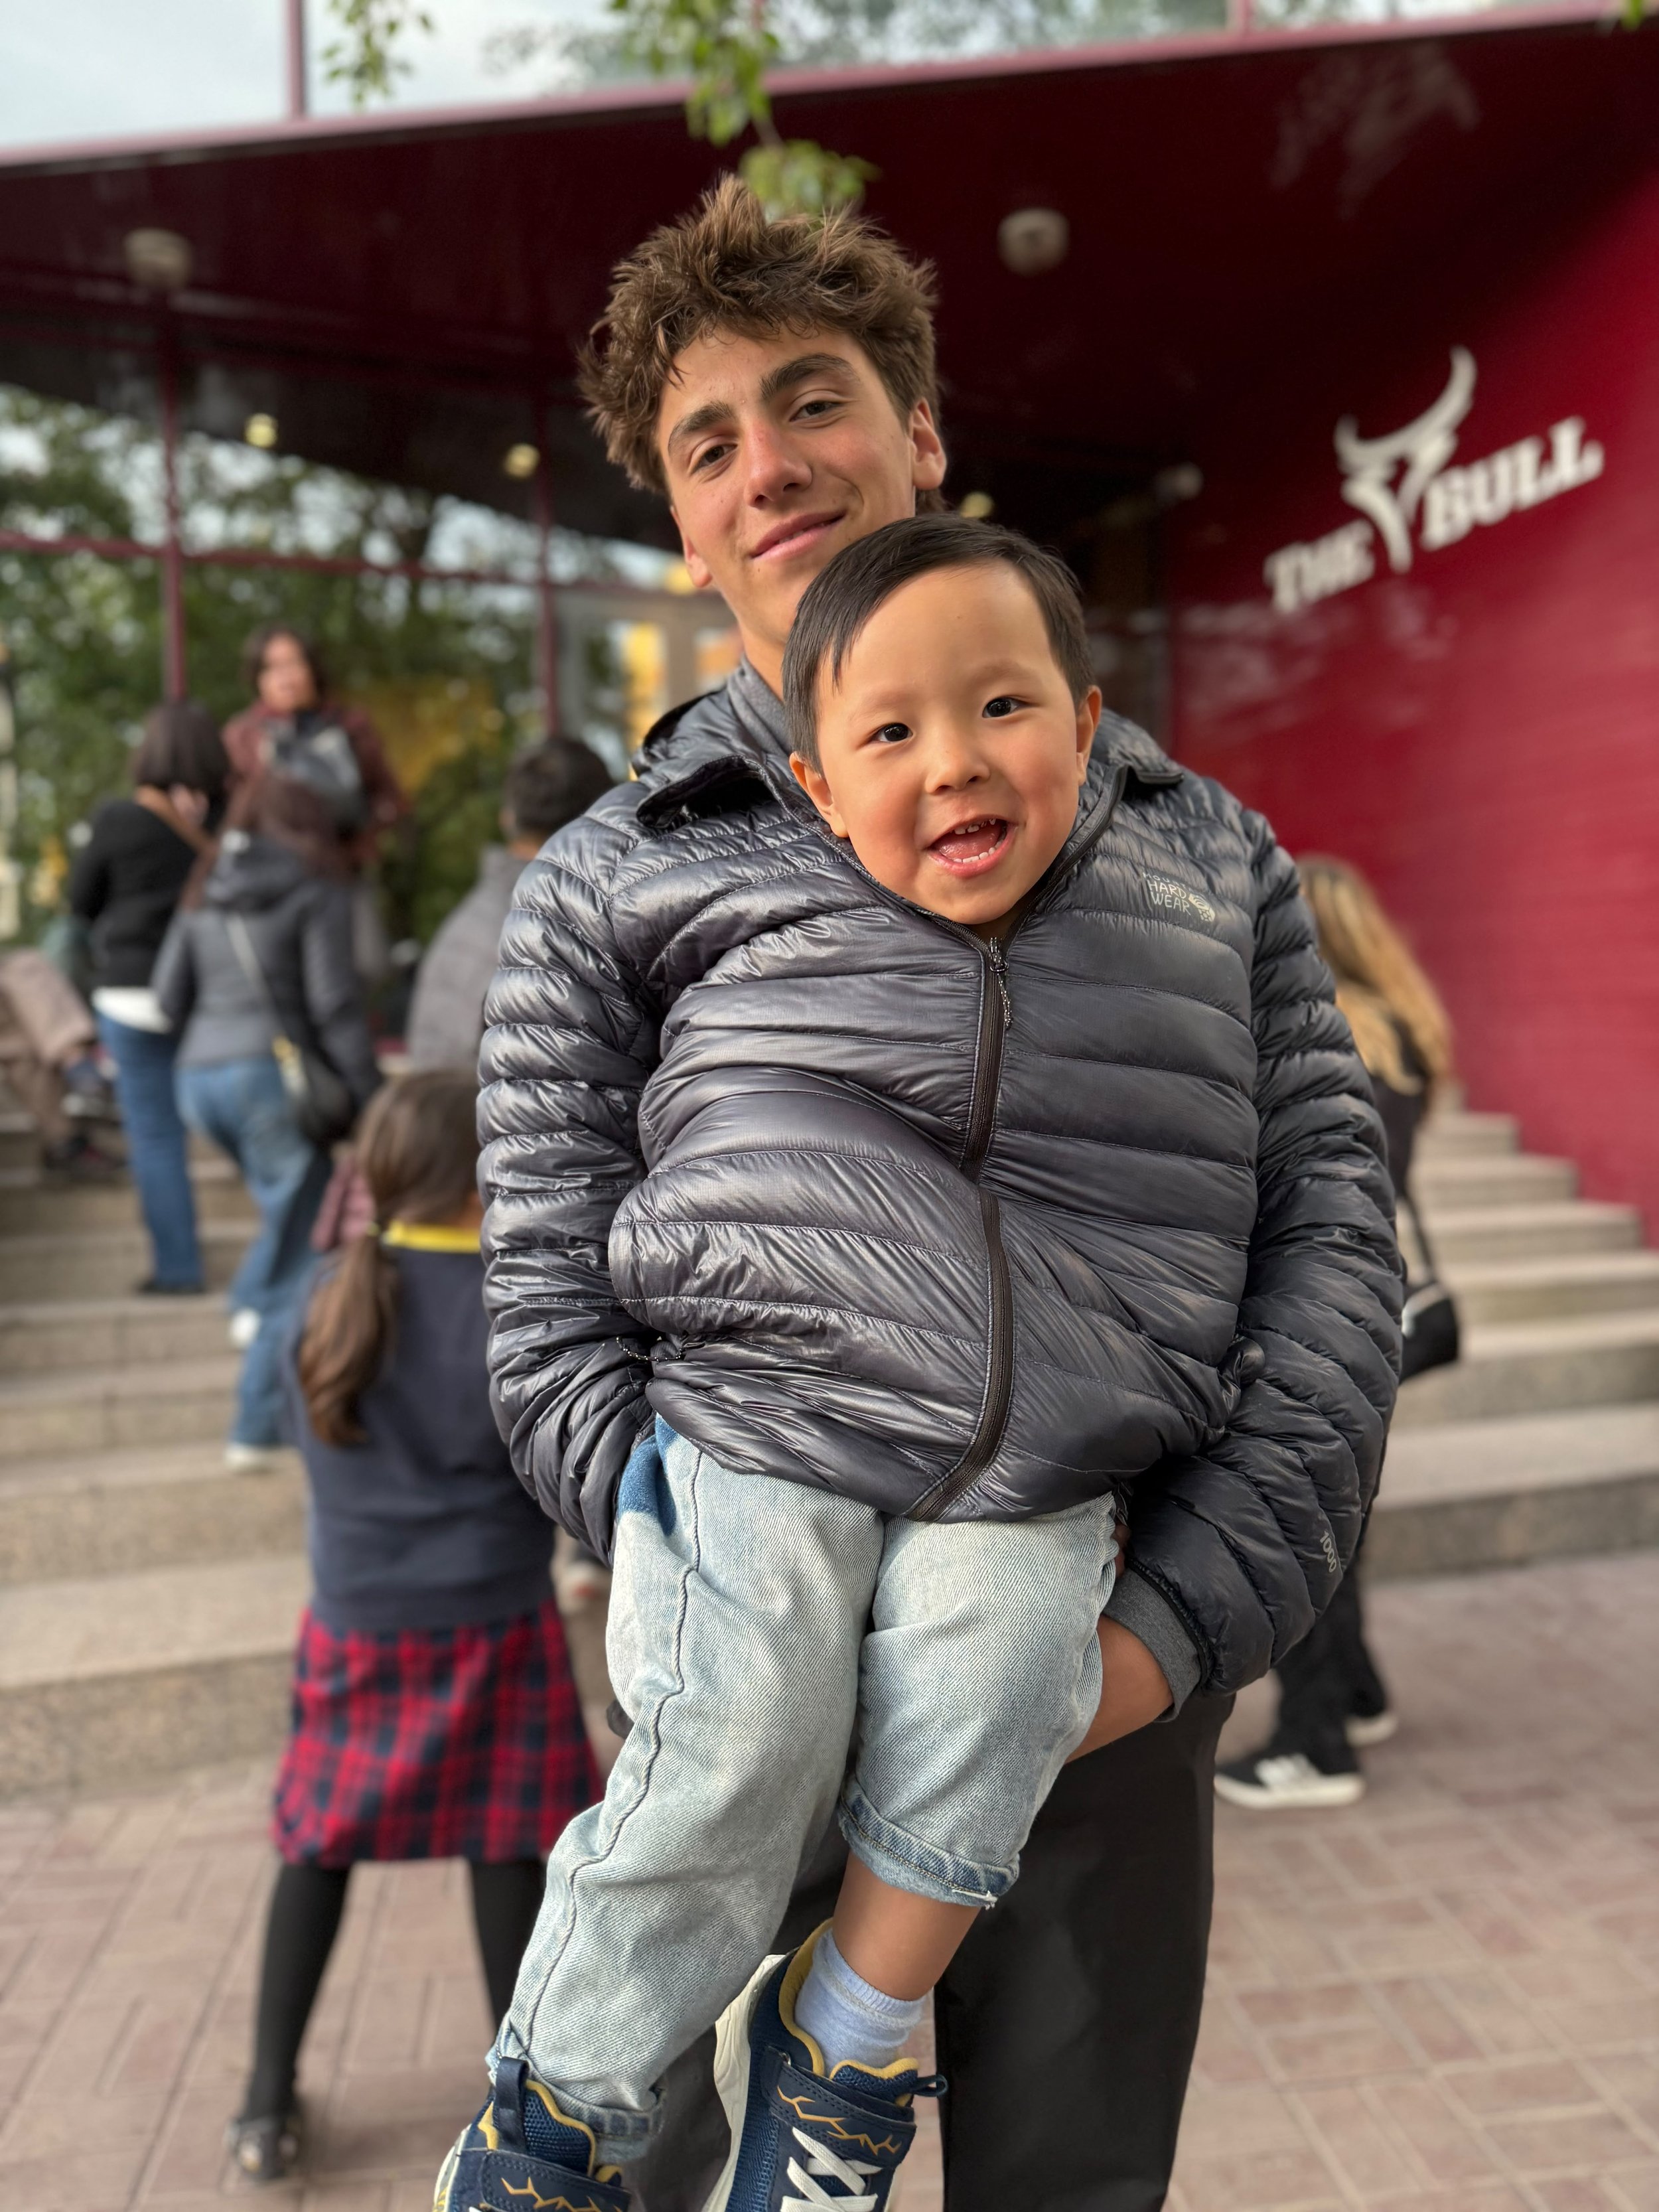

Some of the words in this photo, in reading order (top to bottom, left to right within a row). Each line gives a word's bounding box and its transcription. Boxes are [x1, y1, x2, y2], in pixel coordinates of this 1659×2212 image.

[1263, 518, 1374, 615] THE
[1422, 415, 1604, 551] BULL
[1147, 879, 1187, 899] HARD
[1150, 891, 1191, 916] WEAR
[1319, 1530, 1336, 1573] 1000
